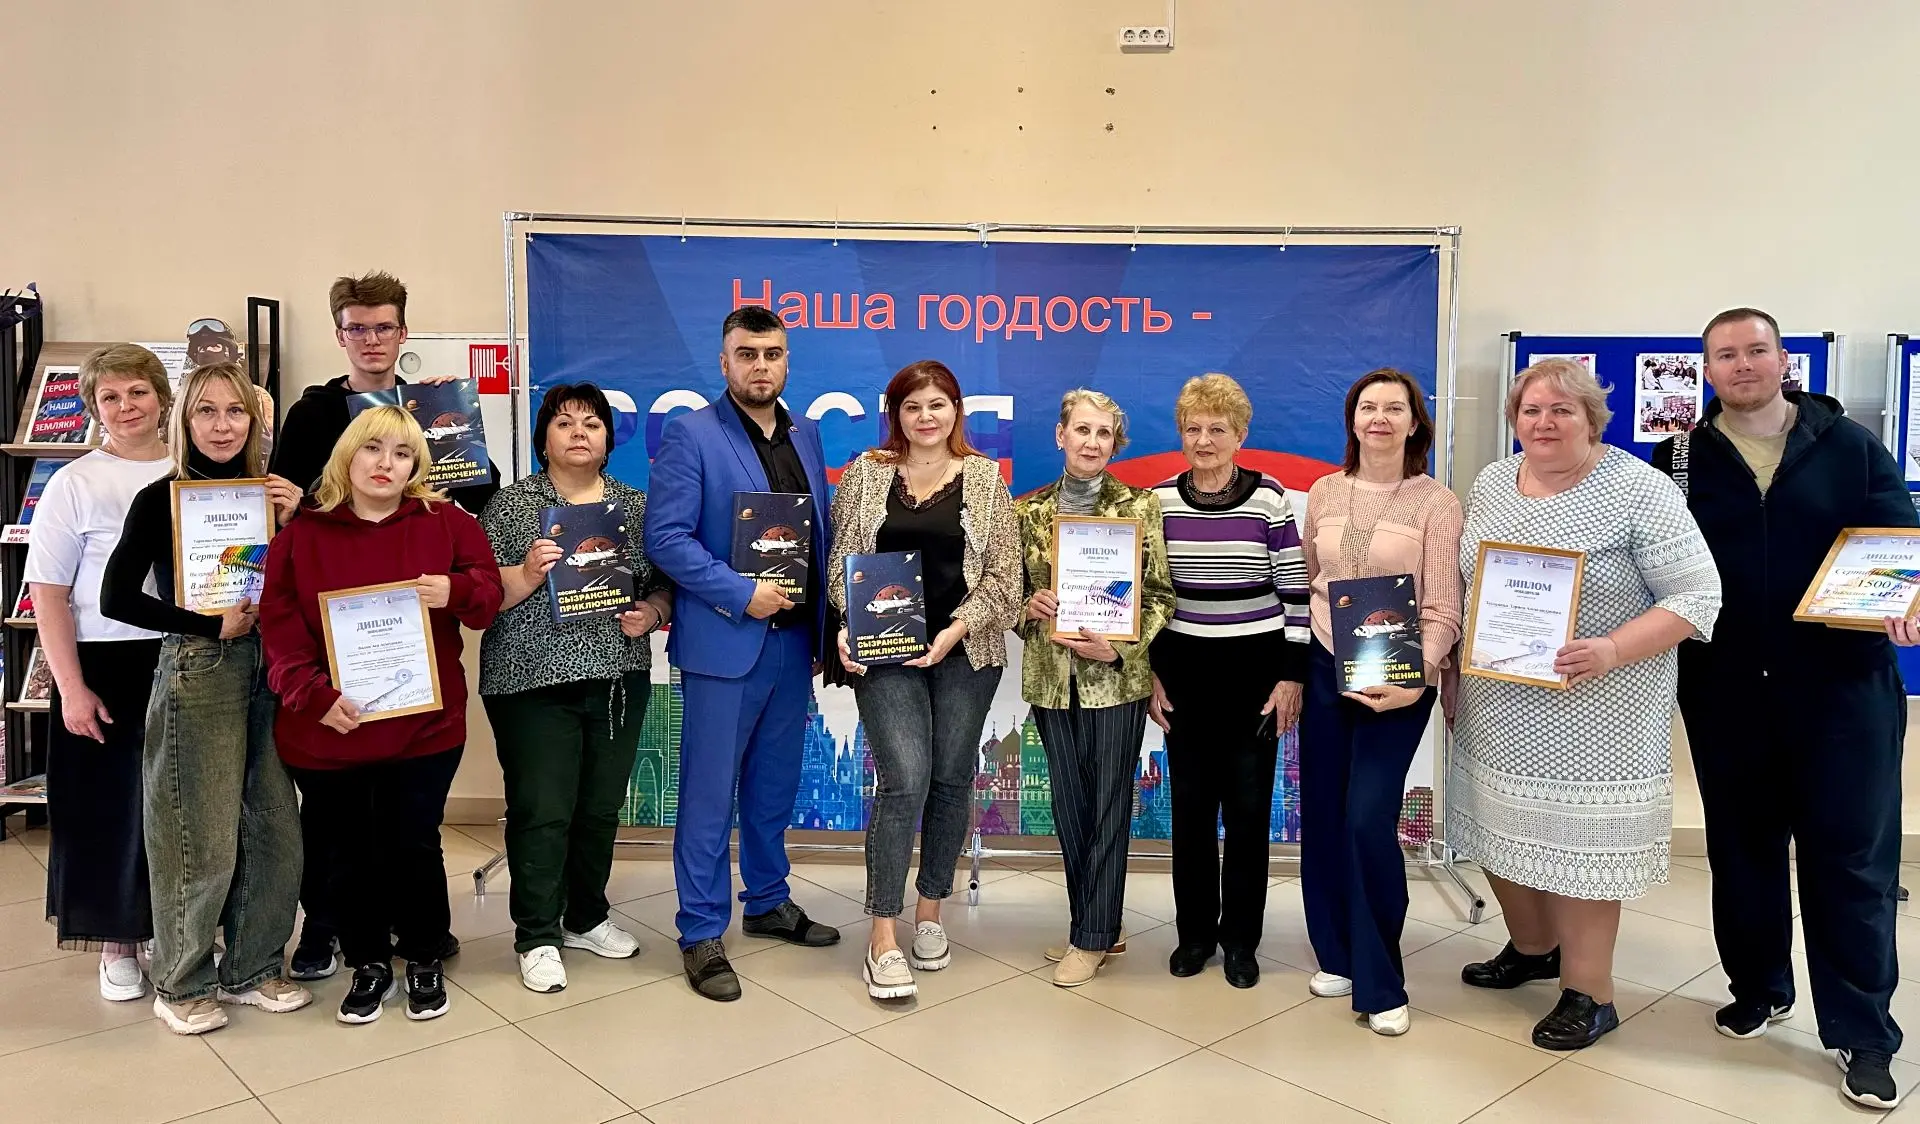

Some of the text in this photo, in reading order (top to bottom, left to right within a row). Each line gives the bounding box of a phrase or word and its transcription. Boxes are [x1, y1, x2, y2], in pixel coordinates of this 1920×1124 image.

[733, 278, 896, 331] Наша
[918, 294, 1173, 343] гордость
[45, 383, 72, 393] ГЕРОИ
[49, 401, 76, 411] НАШИ
[34, 420, 76, 432] ЗЕМЛЯКИ
[430, 461, 478, 472] ЗРАНСКИЕ
[204, 513, 248, 524] ДИПЛОМ
[1079, 547, 1118, 556] ДИПЛОМ
[216, 562, 245, 575] 1500
[1505, 578, 1552, 592] ДИПЛОМ
[1858, 580, 1892, 589] 1500
[558, 588, 622, 604] СЫЗРАНСКИЕ
[1085, 594, 1110, 606] 1500
[559, 596, 631, 613] ПРИКЛЮЧЕНИЯ
[357, 616, 402, 632] ДИПЛОМ
[857, 636, 916, 648] СЫЗРАНСКИЕ
[858, 644, 925, 657] ПРИКЛЮЧЕНИЯ
[1344, 663, 1411, 673] СЫСКИЕ
